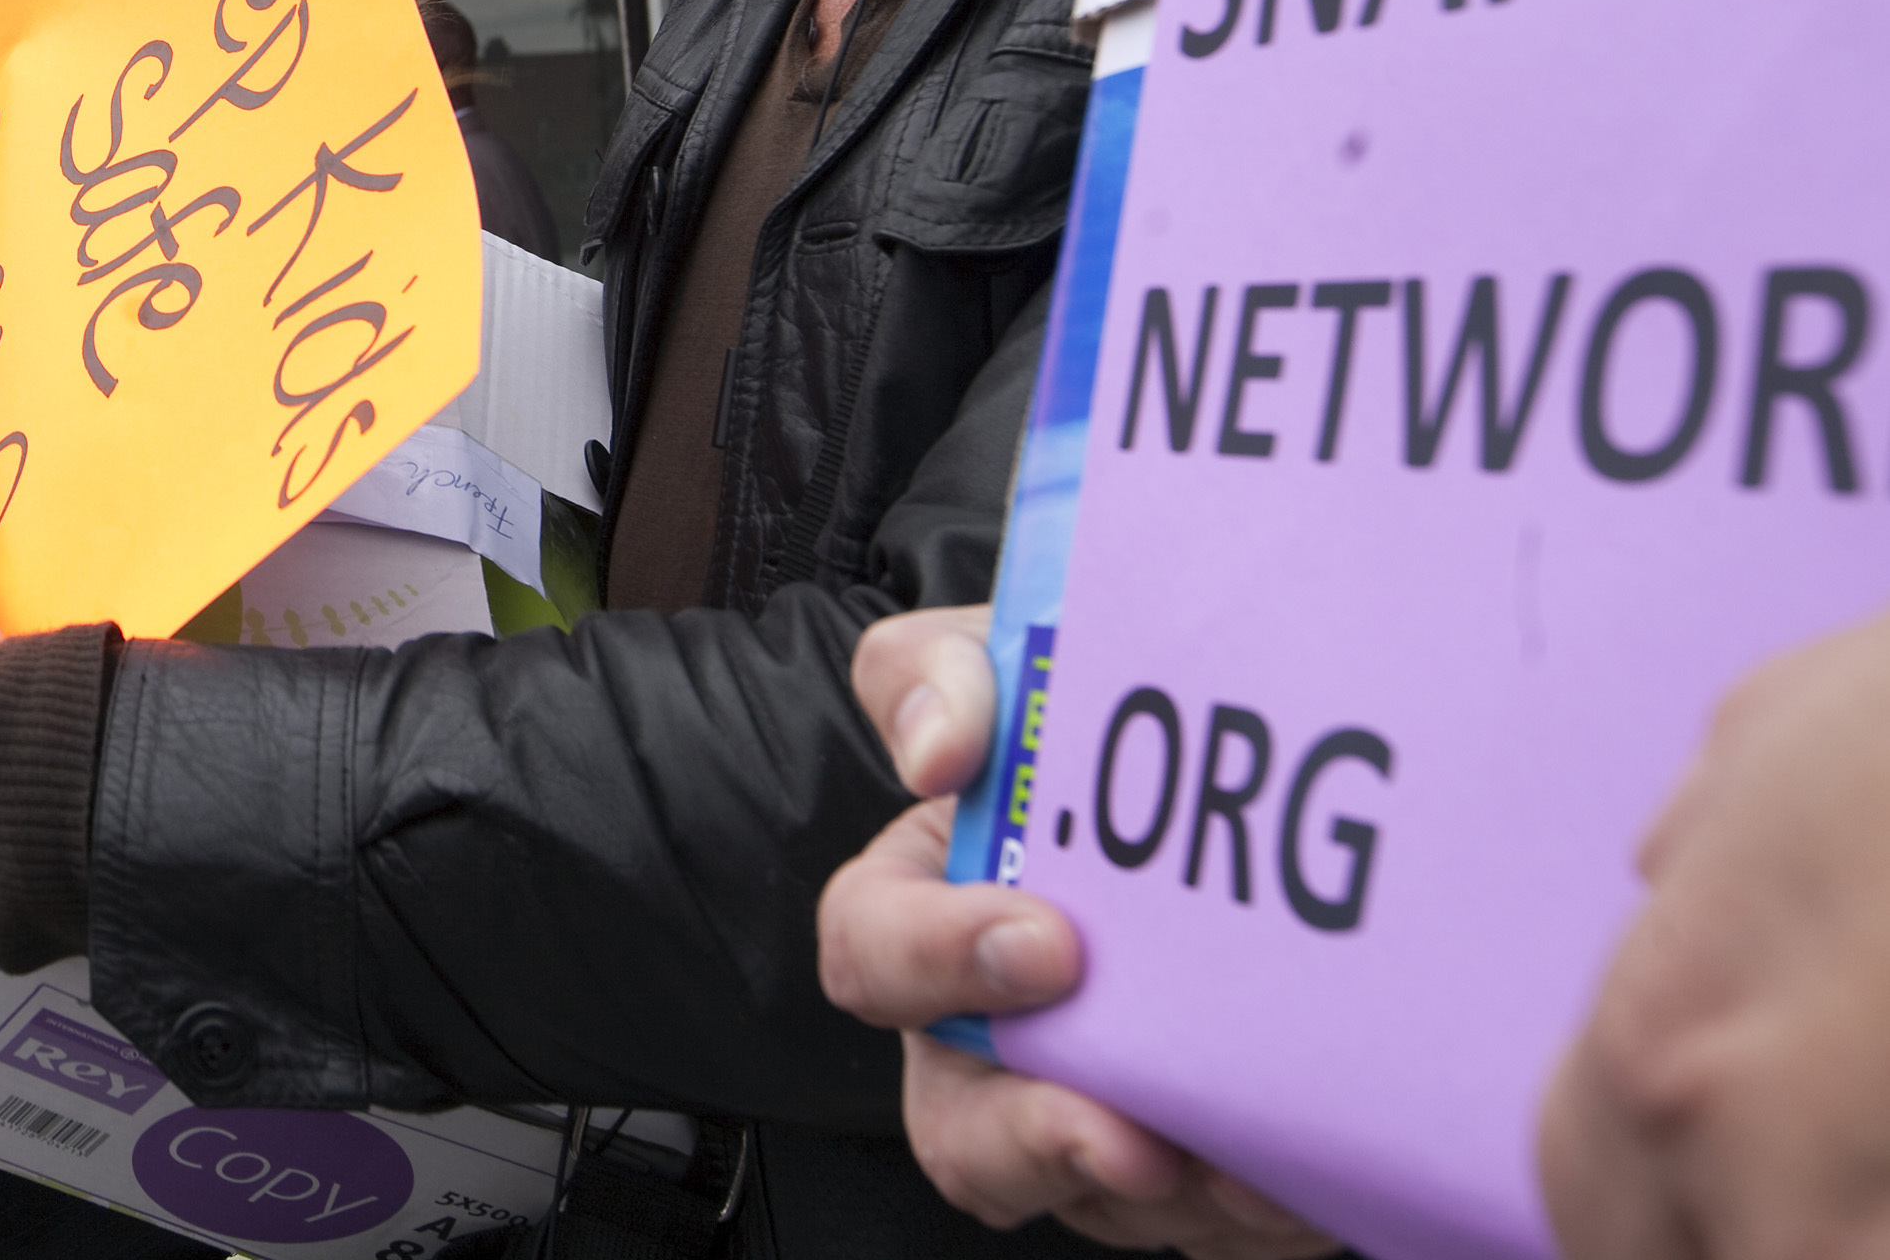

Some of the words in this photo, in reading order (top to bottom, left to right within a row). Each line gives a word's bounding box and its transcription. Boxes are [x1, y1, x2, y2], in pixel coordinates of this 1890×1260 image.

[248, 88, 418, 509] Kids
[1119, 265, 1890, 496] NETWOR
[404, 460, 515, 540] French
[1053, 684, 1397, 935] .ORG
[168, 1126, 379, 1224] Copy
